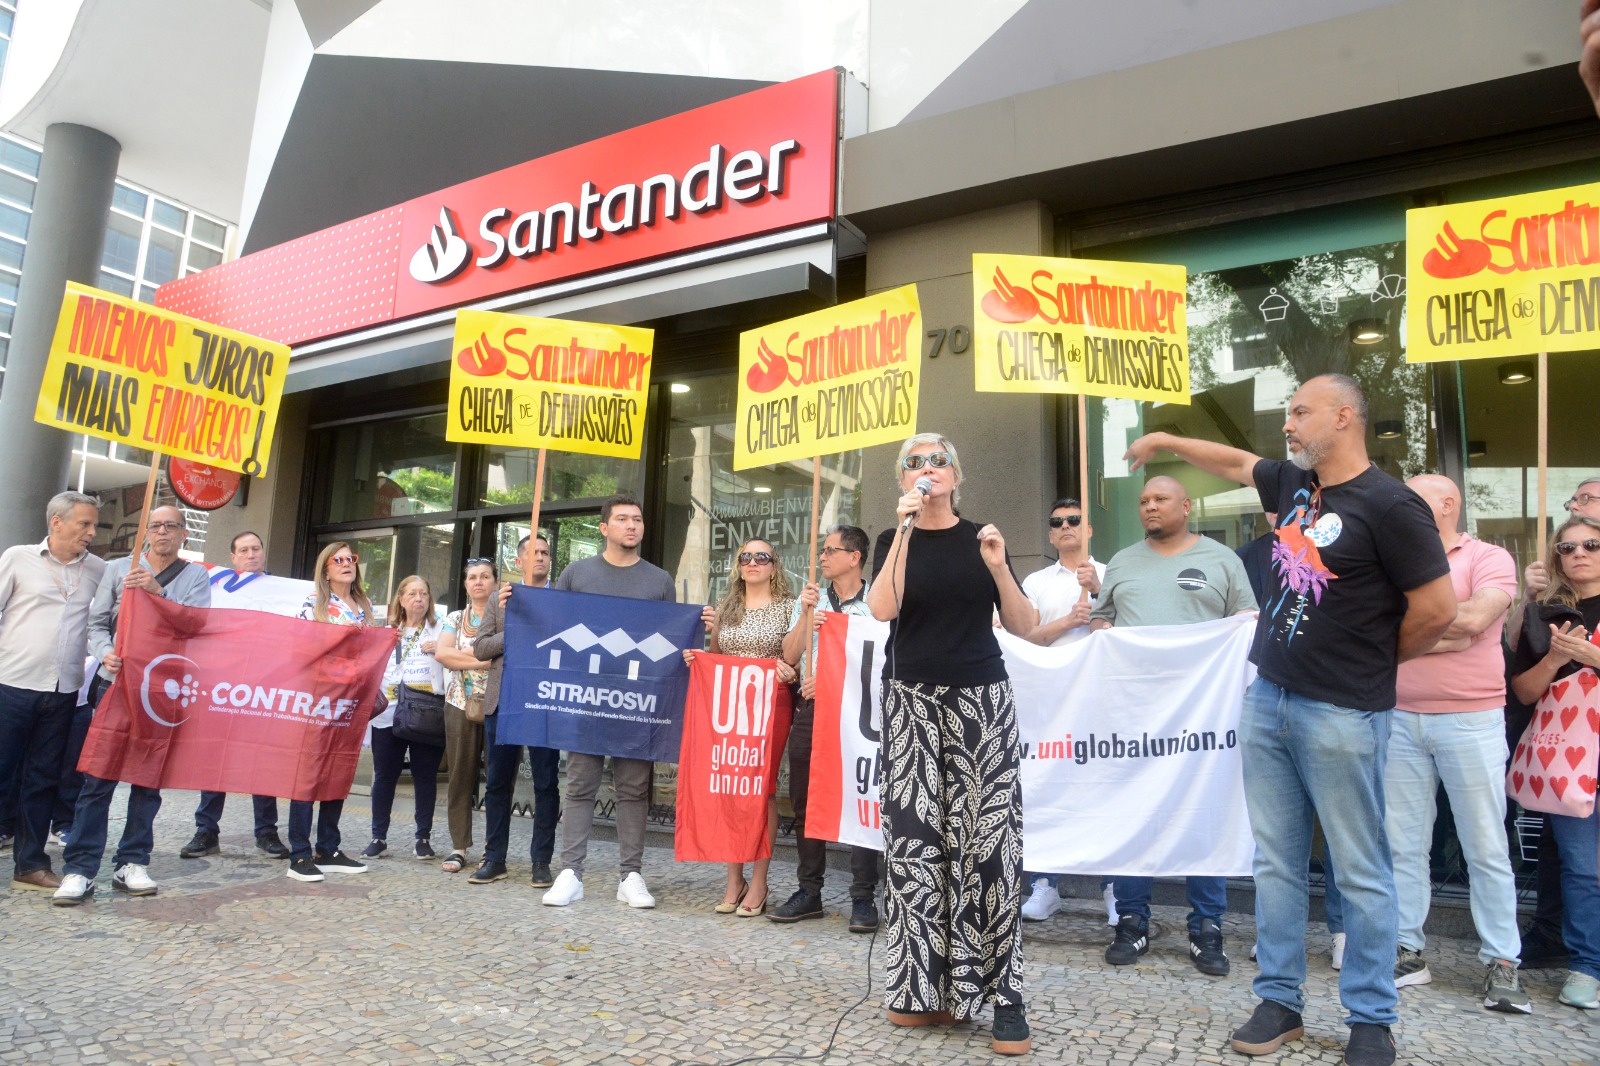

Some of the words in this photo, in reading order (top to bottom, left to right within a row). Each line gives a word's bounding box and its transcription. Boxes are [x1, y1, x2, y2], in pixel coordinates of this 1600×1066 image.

[476, 139, 798, 267] Santander
[1031, 269, 1184, 334] Santander
[1426, 287, 1512, 346] CHEGA
[1512, 297, 1534, 319] de
[68, 294, 176, 378] MENOS
[184, 328, 274, 406] JUROS
[504, 327, 651, 392] Santander
[786, 309, 916, 388] Santander
[927, 324, 970, 359] 70
[997, 330, 1069, 383] CHEGA
[1067, 344, 1082, 363] de
[1084, 336, 1183, 392] DEMISSÕES
[55, 362, 139, 437] MAIS
[460, 386, 513, 434] CHEGA
[519, 403, 533, 420] DE
[539, 391, 637, 446] DEMISSÕES
[746, 395, 800, 454] CHEGA
[801, 401, 816, 423] de
[816, 368, 914, 440] DEMISSÕES
[176, 480, 195, 504] DOLLAR
[196, 489, 234, 507] WITHDRAWAL
[183, 473, 228, 489] EXCHANGE
[208, 704, 239, 714] Confederação
[240, 708, 262, 716] Nacional
[273, 712, 308, 723] Trabalhadores
[211, 682, 354, 721] CONTRAF
[524, 702, 549, 710] Sindicato
[557, 705, 592, 715] Trabajadores
[601, 711, 618, 719] Fondo
[537, 681, 657, 713] SITRAFOSVI
[711, 664, 775, 737] UNI
[709, 768, 763, 796] union
[711, 737, 766, 771] global
